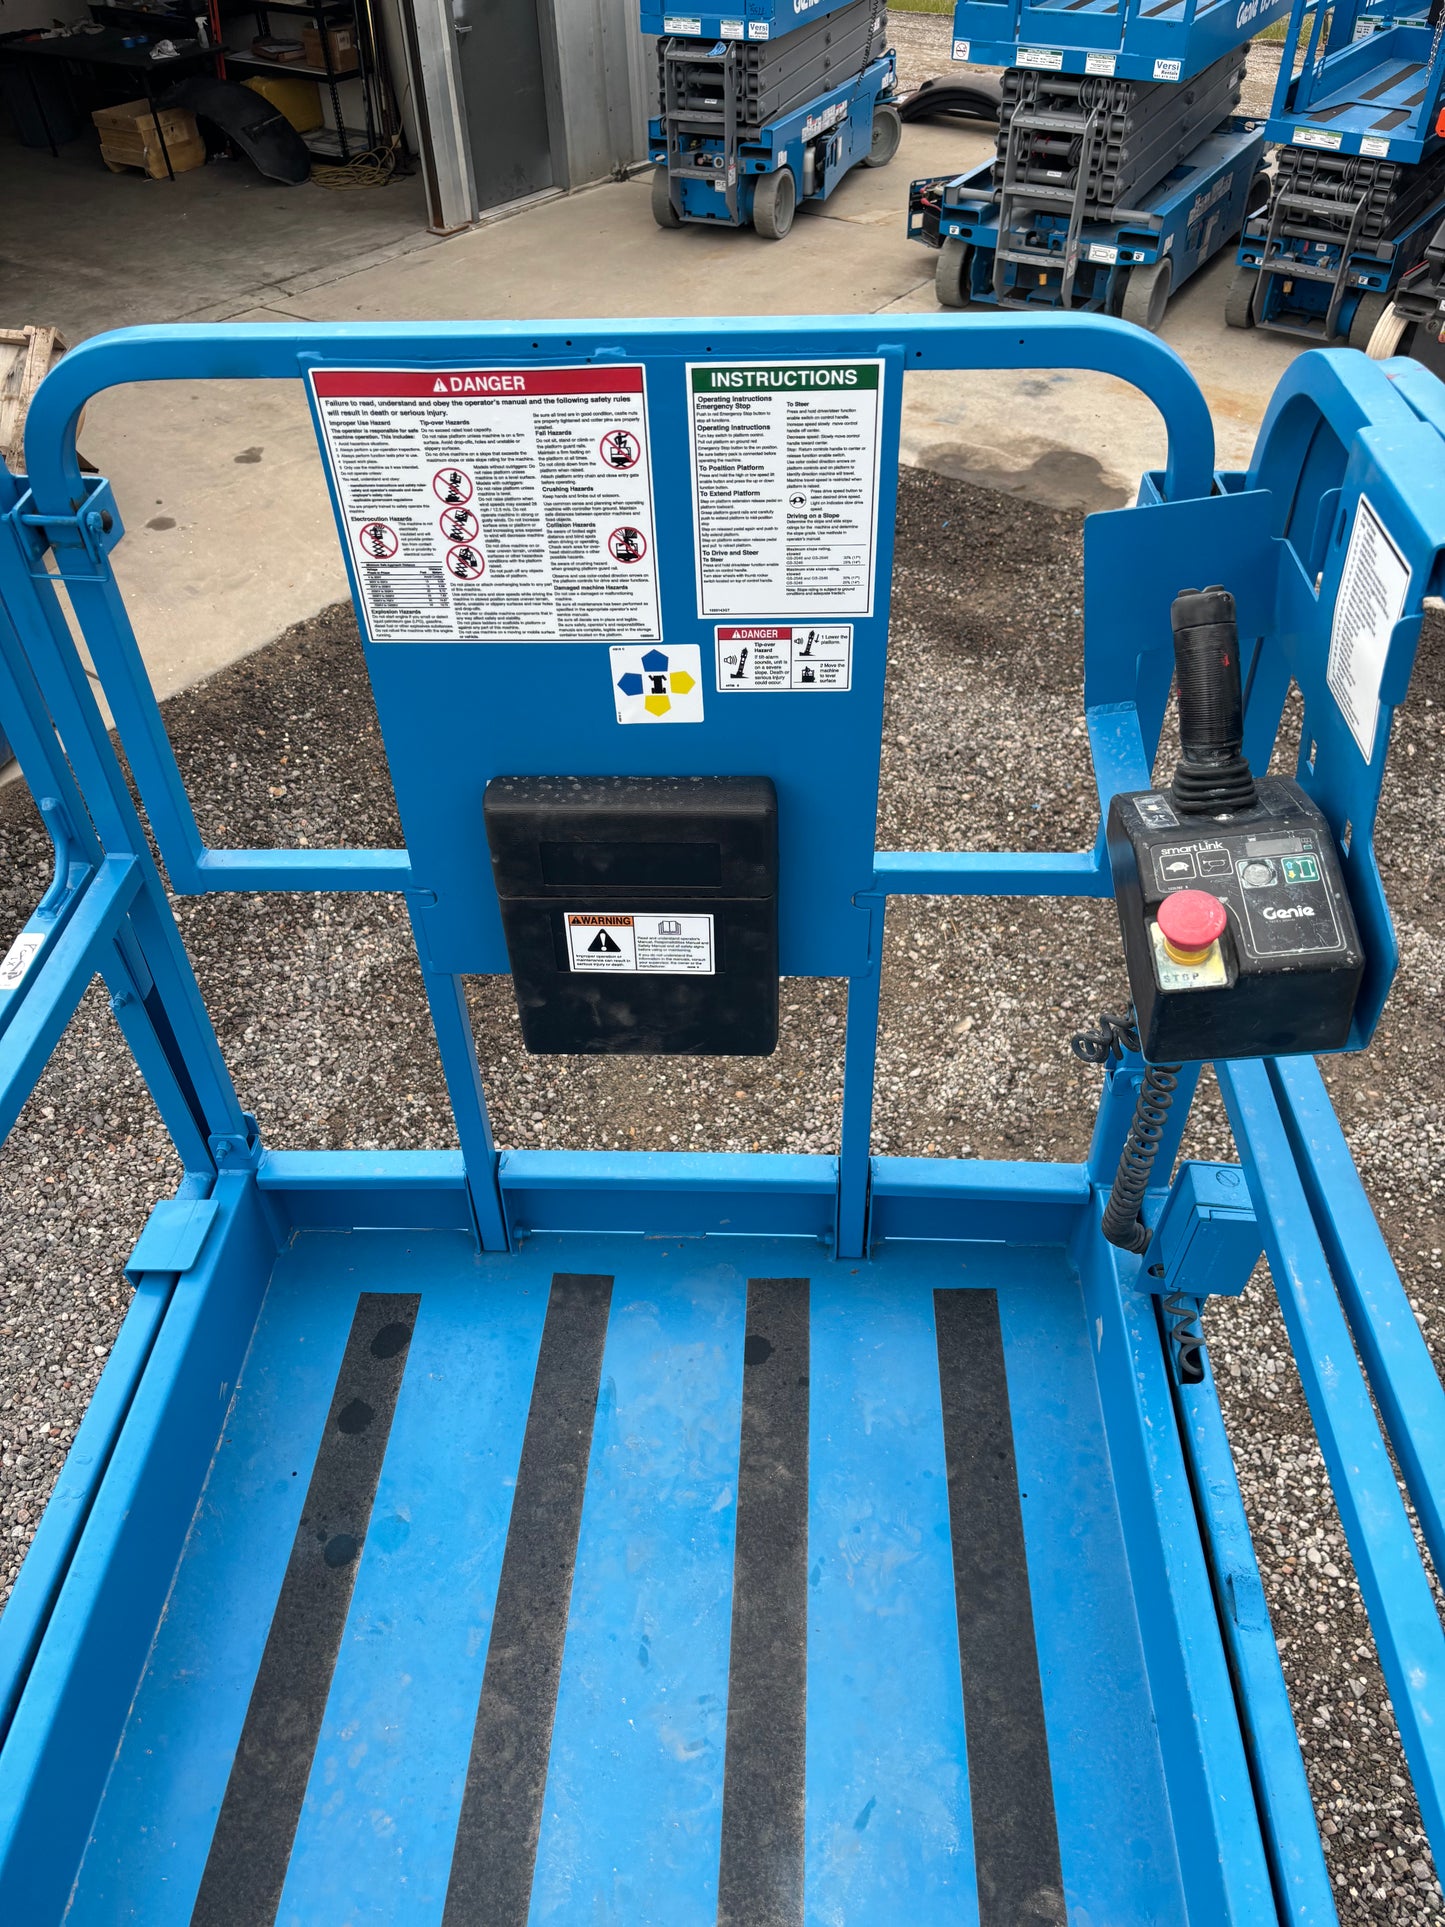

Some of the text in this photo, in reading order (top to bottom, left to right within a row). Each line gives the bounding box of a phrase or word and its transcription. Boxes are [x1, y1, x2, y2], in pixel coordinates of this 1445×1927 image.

[750, 24, 768, 32] Versi
[1156, 61, 1180, 71] Versi
[450, 376, 526, 392] DANGER
[711, 369, 858, 388] INSTRUCTIONS
[359, 400, 376, 408] read,
[464, 399, 500, 408] operator's
[556, 396, 589, 405] following
[590, 396, 612, 404] safety
[426, 409, 448, 417] injury.
[741, 630, 778, 639] DANGER
[1161, 840, 1223, 855] smart Link
[1262, 905, 1316, 920] Genie
[580, 916, 632, 925] WARNING
[1164, 972, 1199, 983] STOP
